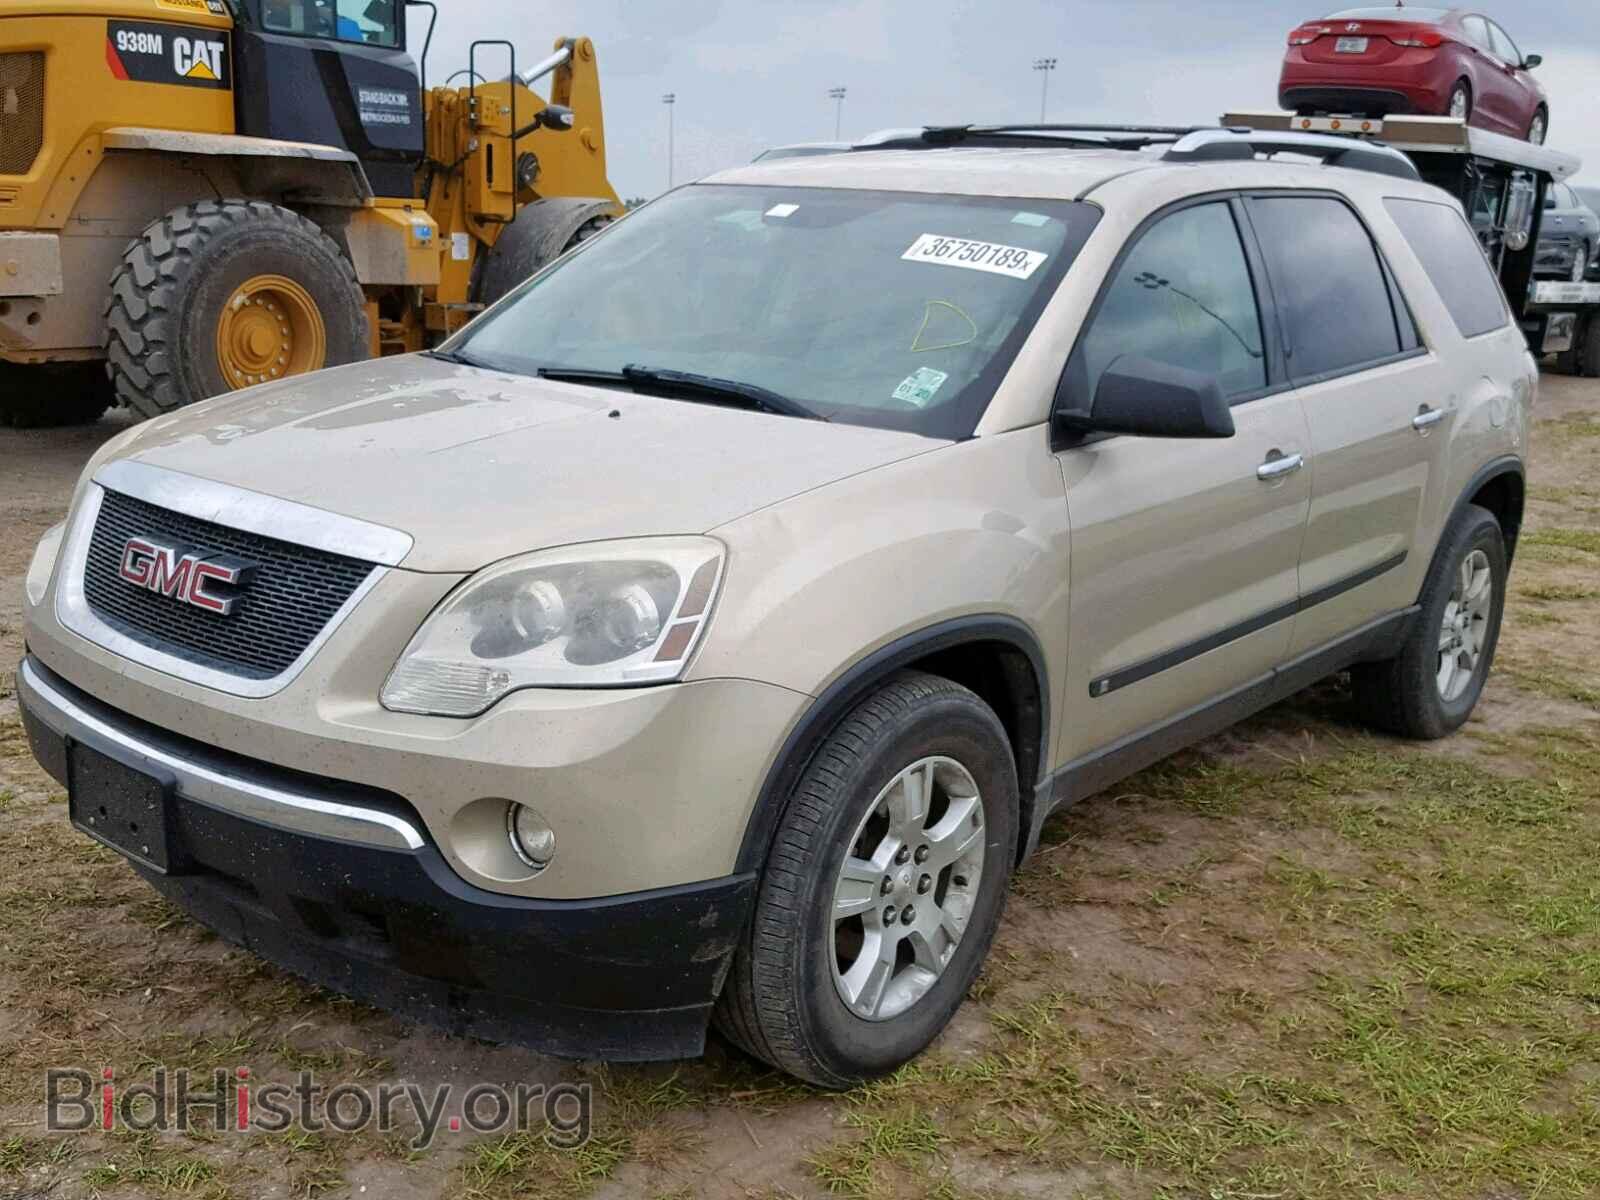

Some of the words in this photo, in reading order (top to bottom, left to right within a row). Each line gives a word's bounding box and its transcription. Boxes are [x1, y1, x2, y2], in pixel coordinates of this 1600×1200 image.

[116, 30, 163, 55] 938M
[173, 37, 225, 80] CAT
[120, 537, 241, 616] GMC
